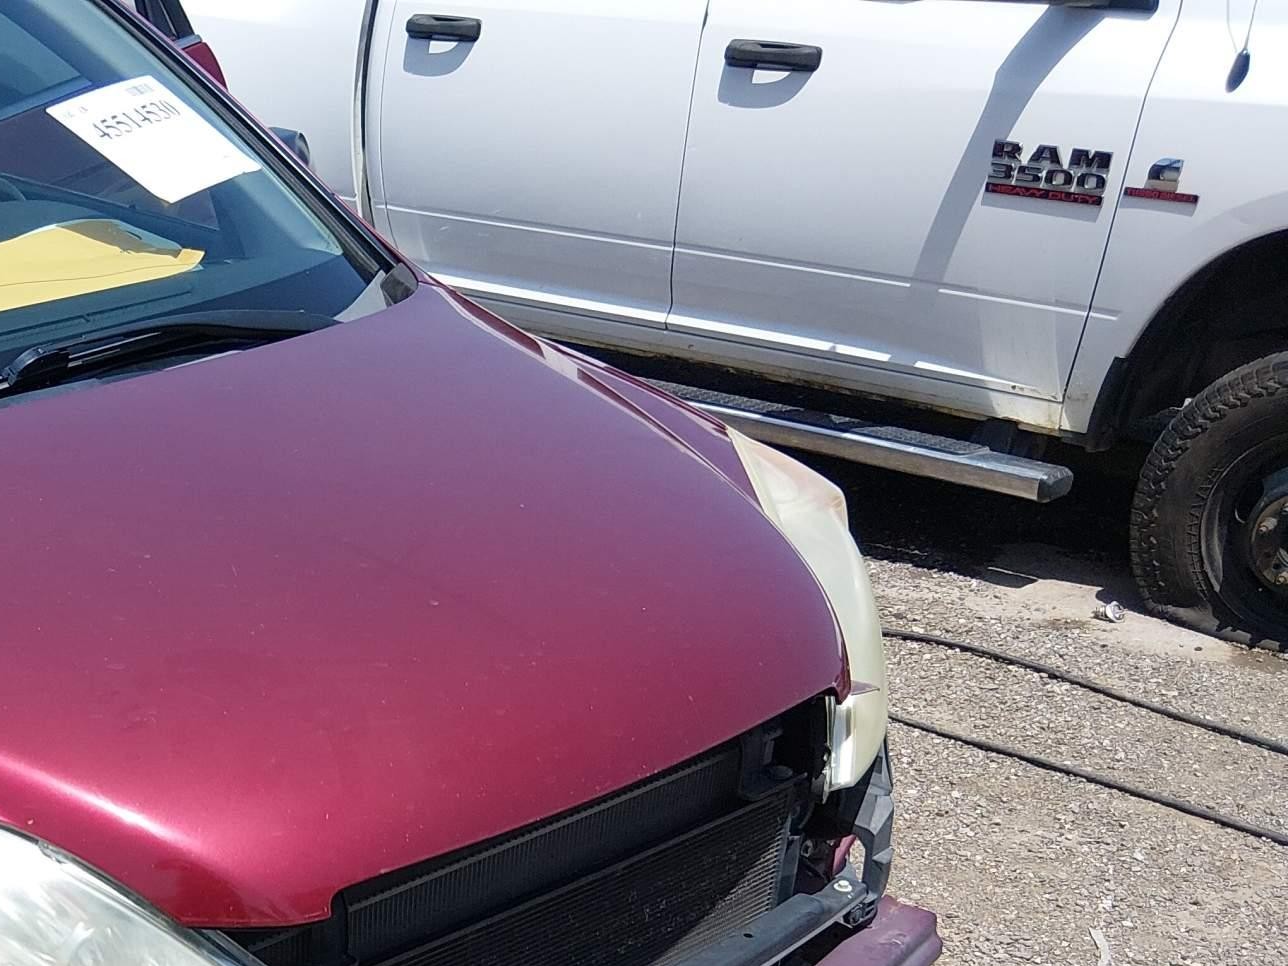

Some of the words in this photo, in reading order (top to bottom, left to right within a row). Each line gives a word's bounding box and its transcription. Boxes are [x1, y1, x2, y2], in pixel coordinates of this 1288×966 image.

[93, 100, 182, 140] 45514530
[991, 139, 1114, 169] RAM
[987, 161, 1107, 191] 3500
[987, 183, 1043, 198] HEAVY
[1047, 190, 1099, 204] DUTY
